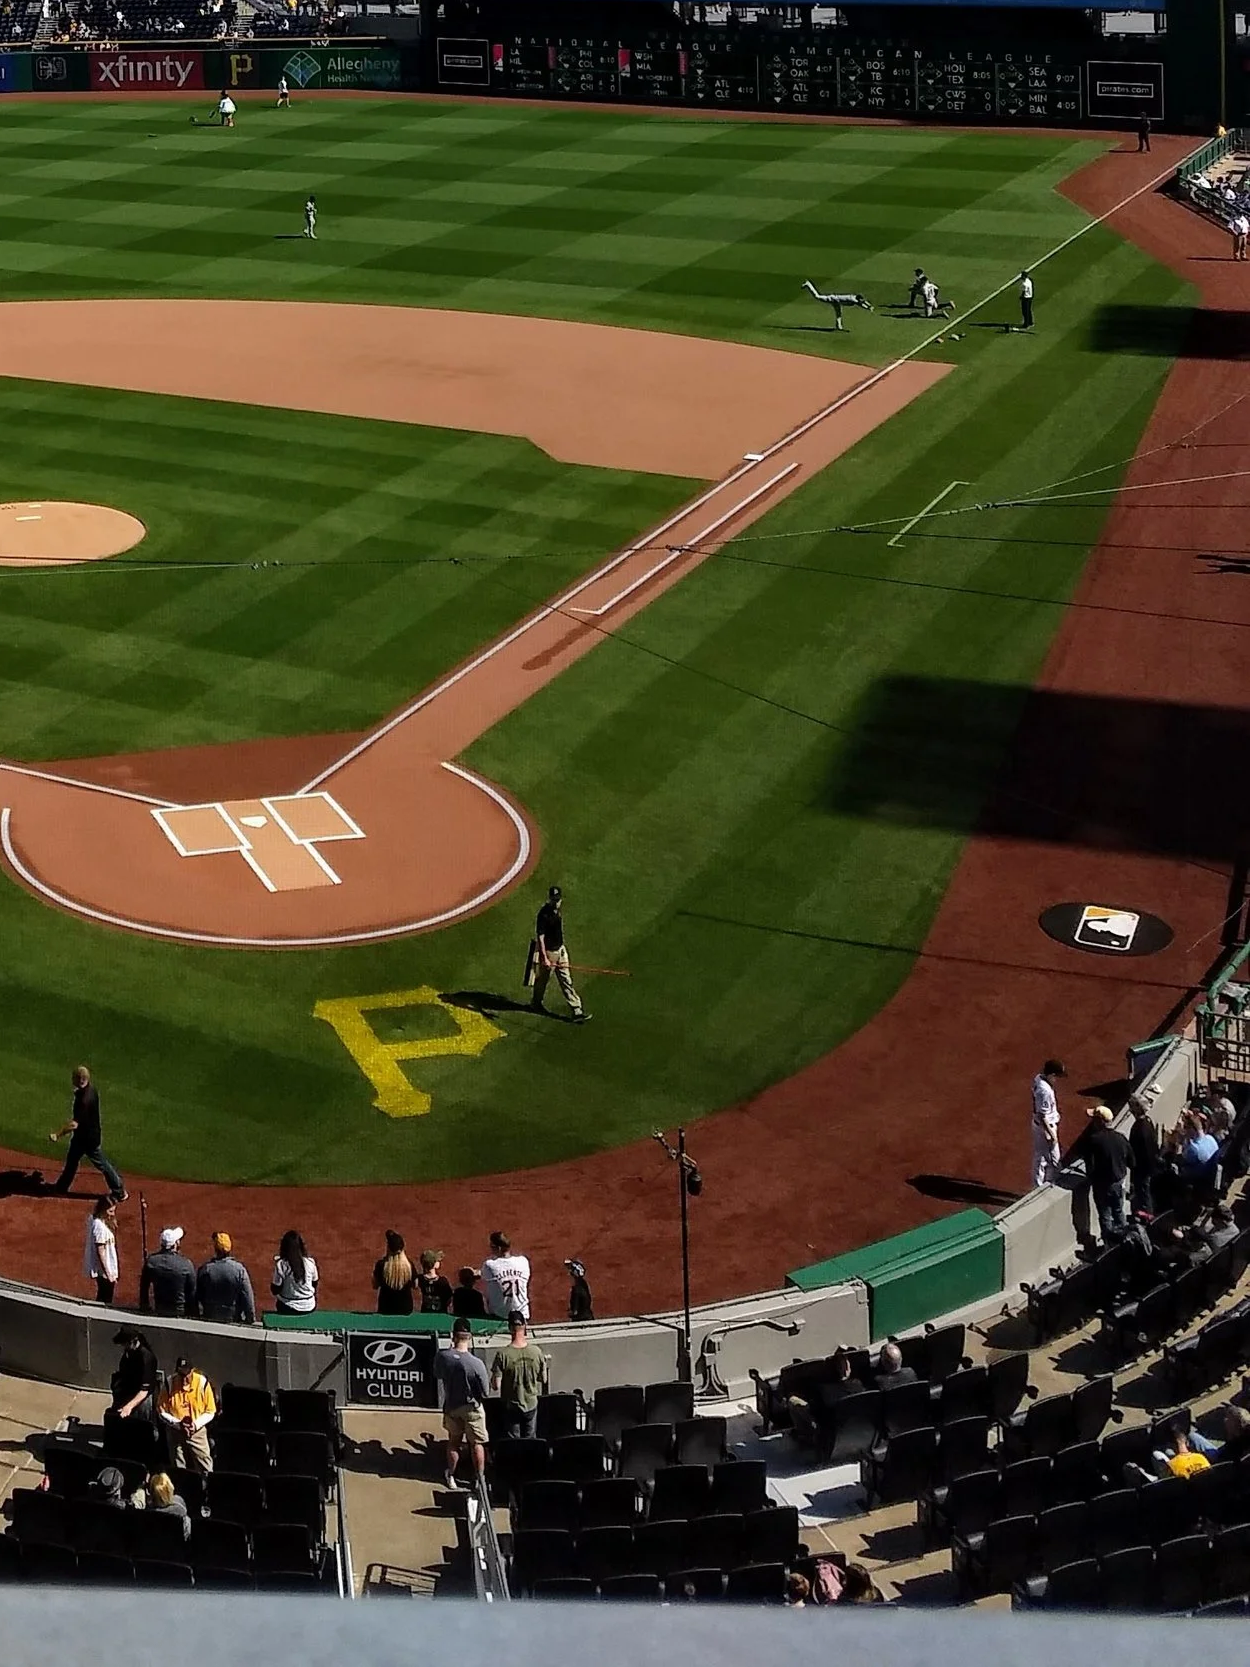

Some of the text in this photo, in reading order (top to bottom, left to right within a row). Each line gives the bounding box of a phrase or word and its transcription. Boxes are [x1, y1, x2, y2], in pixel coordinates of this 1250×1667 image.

[645, 41, 732, 53] LEAGUE
[634, 52, 653, 61] WSH
[789, 46, 1052, 63] AMERICAN LEAGUE
[327, 56, 401, 73] Allegheny
[578, 60, 594, 69] COL
[636, 63, 652, 71] MIA
[790, 58, 809, 67] TOR
[98, 55, 194, 88] xfinity
[230, 54, 253, 86] P
[790, 69, 810, 77] OAK
[866, 61, 910, 76] BOS 6:10
[944, 64, 991, 79] HOU 8:05
[327, 74, 358, 84] Health
[870, 72, 882, 81] TB
[947, 75, 964, 84] TEX
[1029, 67, 1075, 83] SEA 9:07
[714, 79, 730, 88] ATL
[792, 83, 809, 92] ATL
[1028, 79, 1047, 87] LAA
[870, 86, 883, 95] KC
[1101, 85, 1150, 94] pirates.com
[792, 93, 808, 102] CLE
[945, 90, 991, 100] CWS 0
[867, 97, 885, 106] NYY
[947, 101, 991, 112] DET 0
[1028, 94, 1076, 110] MIN 4:05
[1029, 105, 1048, 114] BAL
[312, 984, 508, 1118] P
[502, 1279, 519, 1297] 21
[356, 1367, 424, 1382] HYUNDAI
[367, 1383, 414, 1399] CLUB
